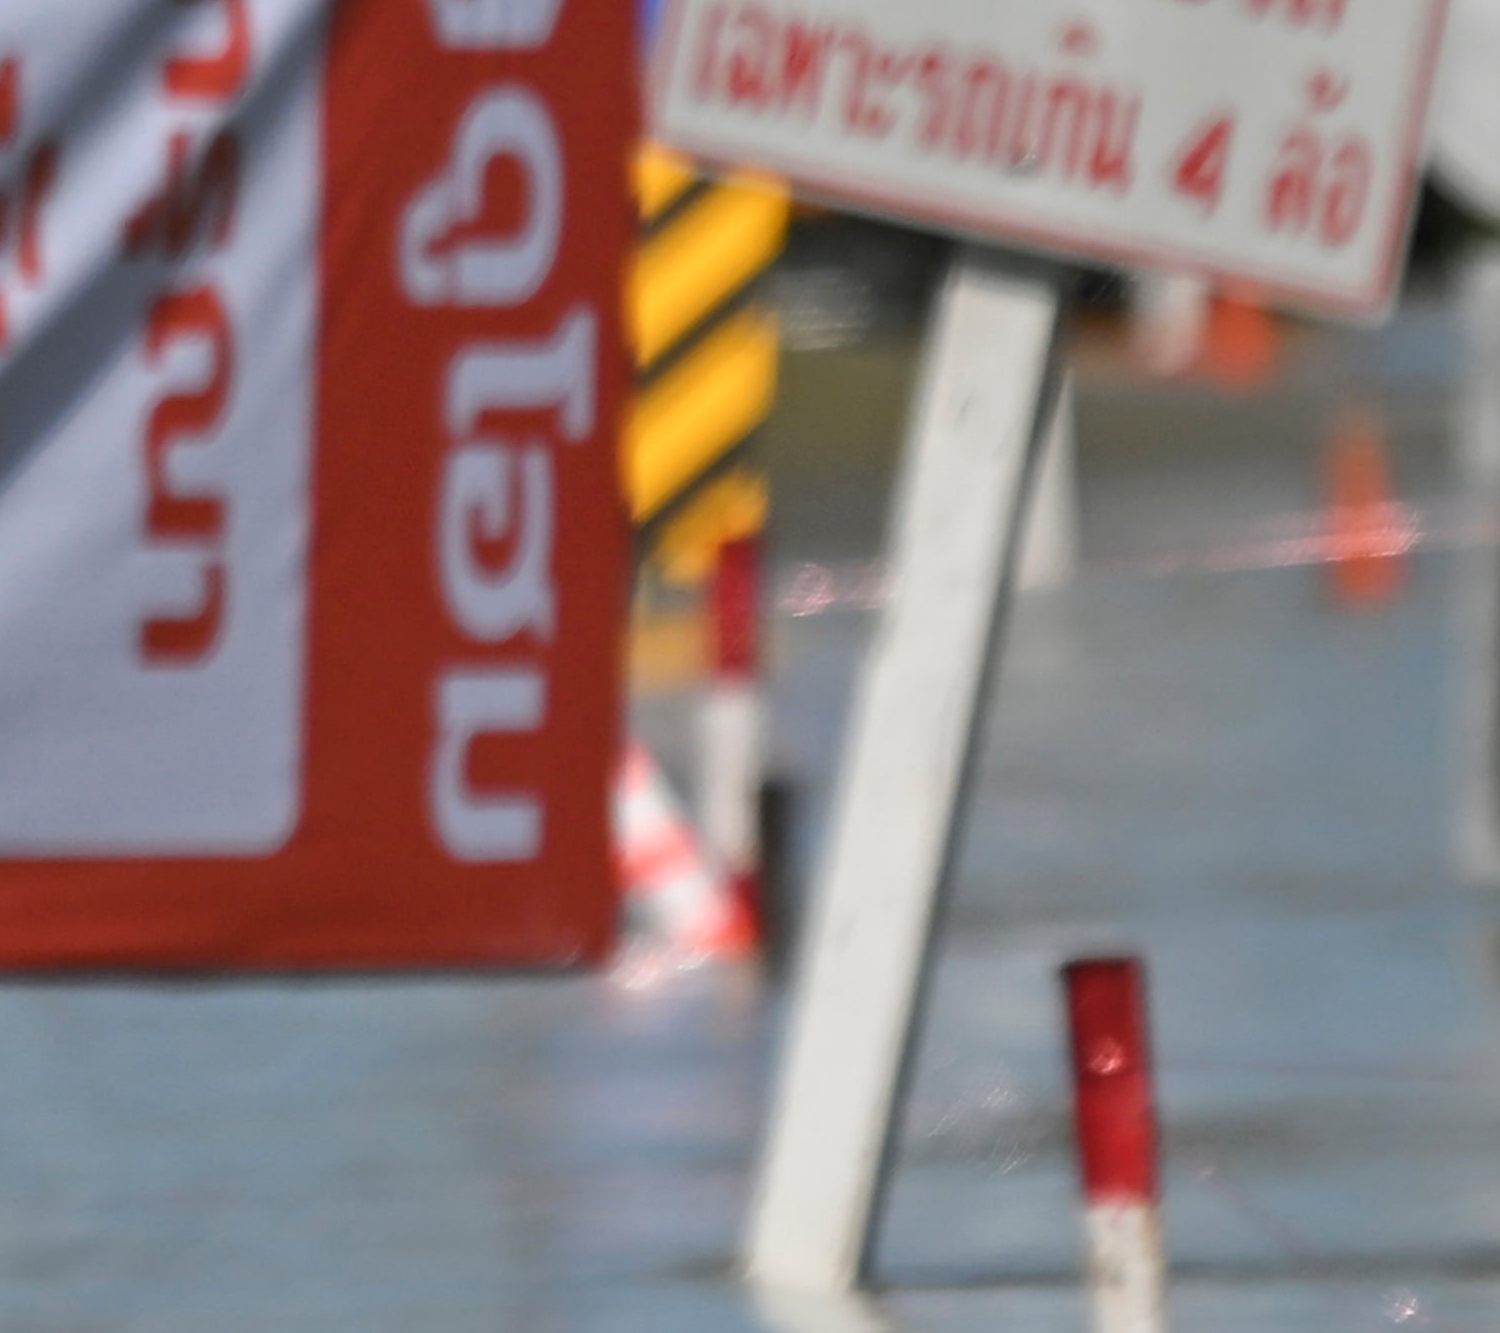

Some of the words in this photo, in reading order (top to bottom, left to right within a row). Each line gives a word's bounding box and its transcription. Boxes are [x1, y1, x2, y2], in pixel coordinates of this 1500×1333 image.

[1169, 110, 1238, 214] 4
[1264, 69, 1378, 251] ล้อ
[395, 83, 596, 862] ดูโฮม
